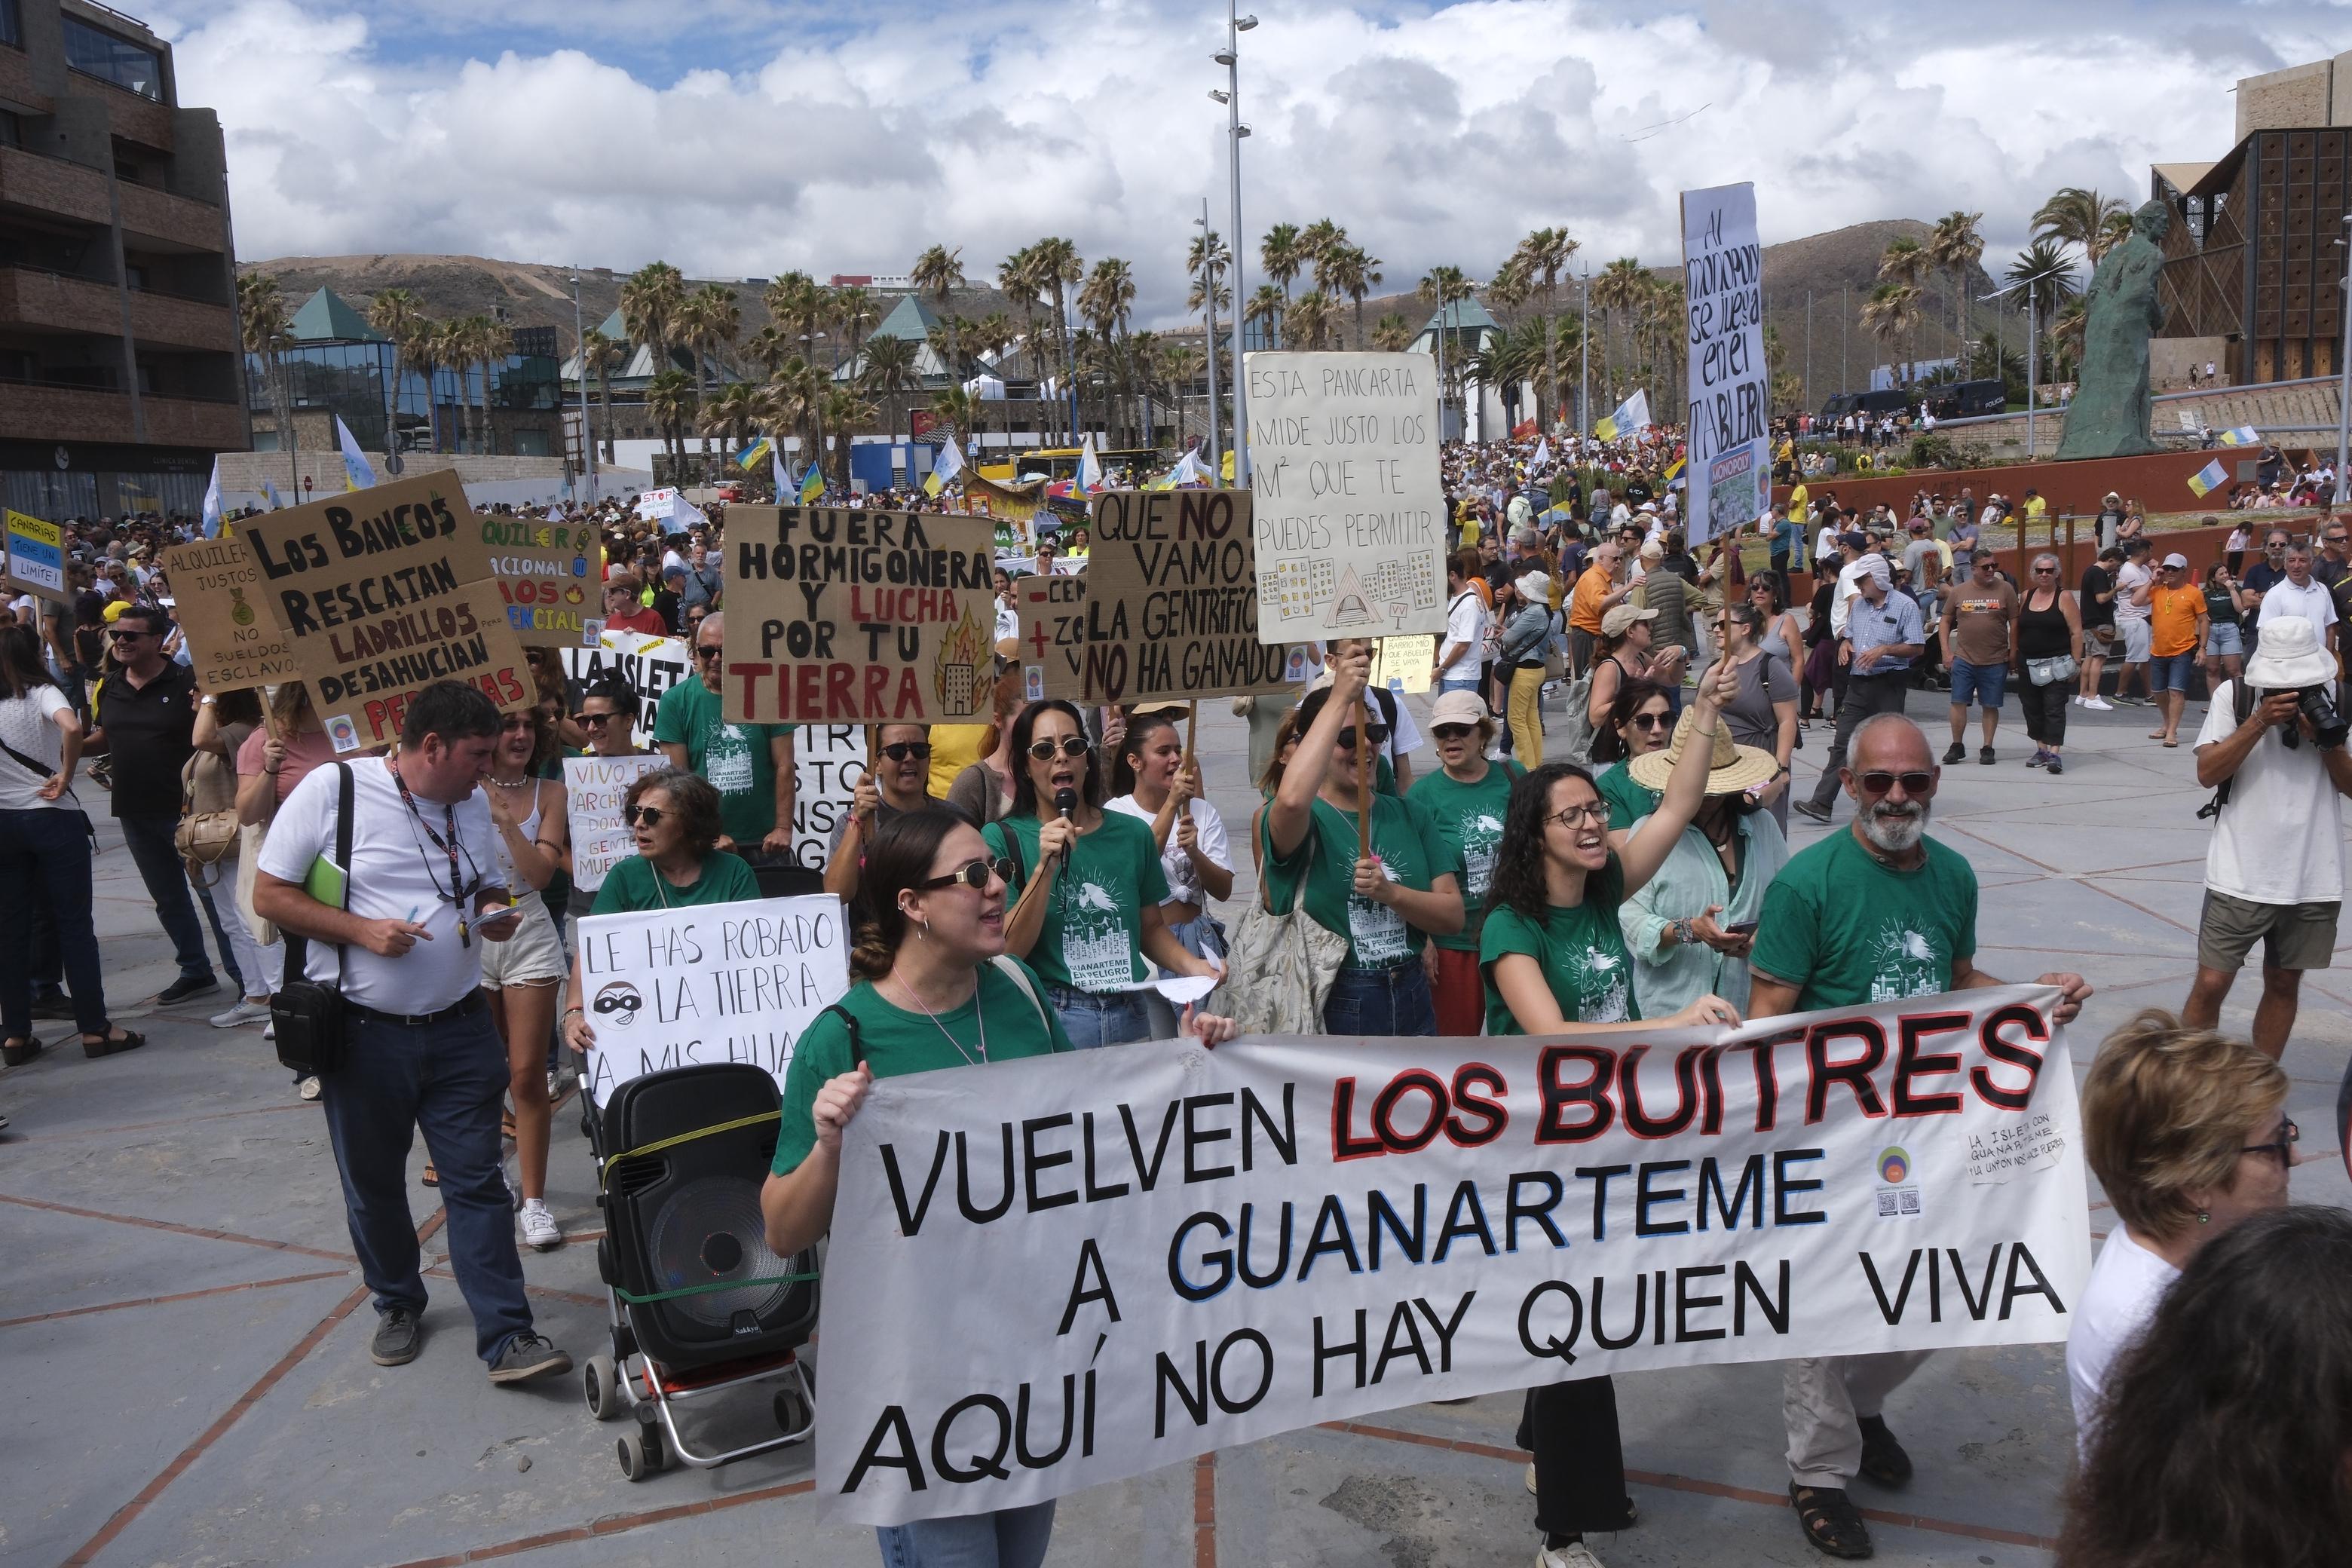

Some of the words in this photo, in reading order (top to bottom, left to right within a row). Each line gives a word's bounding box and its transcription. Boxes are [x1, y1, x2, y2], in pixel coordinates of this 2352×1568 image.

[1691, 302, 1713, 345] se
[1251, 370, 1308, 398] ESTA
[1322, 368, 1417, 397] PANCARTA
[1702, 339, 1727, 387] en
[1256, 415, 1312, 446] MIDE
[1325, 415, 1379, 446] JUSTO
[1393, 415, 1426, 445] LOS
[1689, 378, 1767, 463] TABLERO
[1309, 460, 1357, 500] QUE
[1376, 458, 1405, 495] TE
[1712, 453, 1749, 482] MONOPOLY
[11, 517, 56, 541] CANARIAS
[778, 507, 929, 550] FUERA
[1098, 493, 1171, 541] QUE
[1178, 492, 1233, 541] NO
[1258, 513, 1331, 551] PUEDES
[1345, 510, 1435, 547] PERMITIR
[15, 540, 39, 556] TIENE
[42, 548, 55, 561] UN
[739, 542, 993, 590] HORMIGONERA
[197, 568, 257, 591] JUSTOS
[280, 556, 458, 637] RESCATAN
[798, 582, 827, 622] Y
[851, 585, 959, 624] LUCHA
[1088, 599, 1129, 642] LA
[233, 628, 259, 642] NO
[761, 619, 836, 659] POR
[859, 623, 920, 662] TU
[1388, 641, 1413, 650] BARRIO
[1084, 644, 1128, 701] NO
[1137, 642, 1173, 693] HA
[1182, 637, 1285, 691] GANADO
[728, 663, 924, 720] TIERRA
[575, 762, 625, 784] VIVO
[586, 932, 626, 975] LE
[647, 924, 703, 969] HAS
[722, 912, 833, 961] ROBADO
[1354, 927, 1406, 941] GUANARTEME
[1372, 935, 1404, 948] PELIGRO
[1069, 958, 1129, 972] GUANARTEME
[1073, 971, 1086, 979] EN
[1088, 966, 1129, 978] PELIGRO
[655, 976, 700, 1024] LA
[710, 963, 822, 1017] TIERRA
[593, 1051, 616, 1095] A
[878, 1083, 1298, 1237] VUELVEN
[1331, 1061, 1508, 1162] LOS
[1535, 1003, 2050, 1145] BUITRES
[1968, 1135, 1983, 1149] LA
[2032, 1113, 2050, 1127] CON
[1057, 1238, 1122, 1337] A
[1167, 1148, 1829, 1303] GUANARTEME
[840, 1332, 1116, 1496] AQUÍ
[1153, 1327, 1275, 1440] NO
[1312, 1290, 1477, 1399] HAY
[1517, 1259, 1790, 1365] QUIEN
[1857, 1242, 2067, 1326] VIVA
